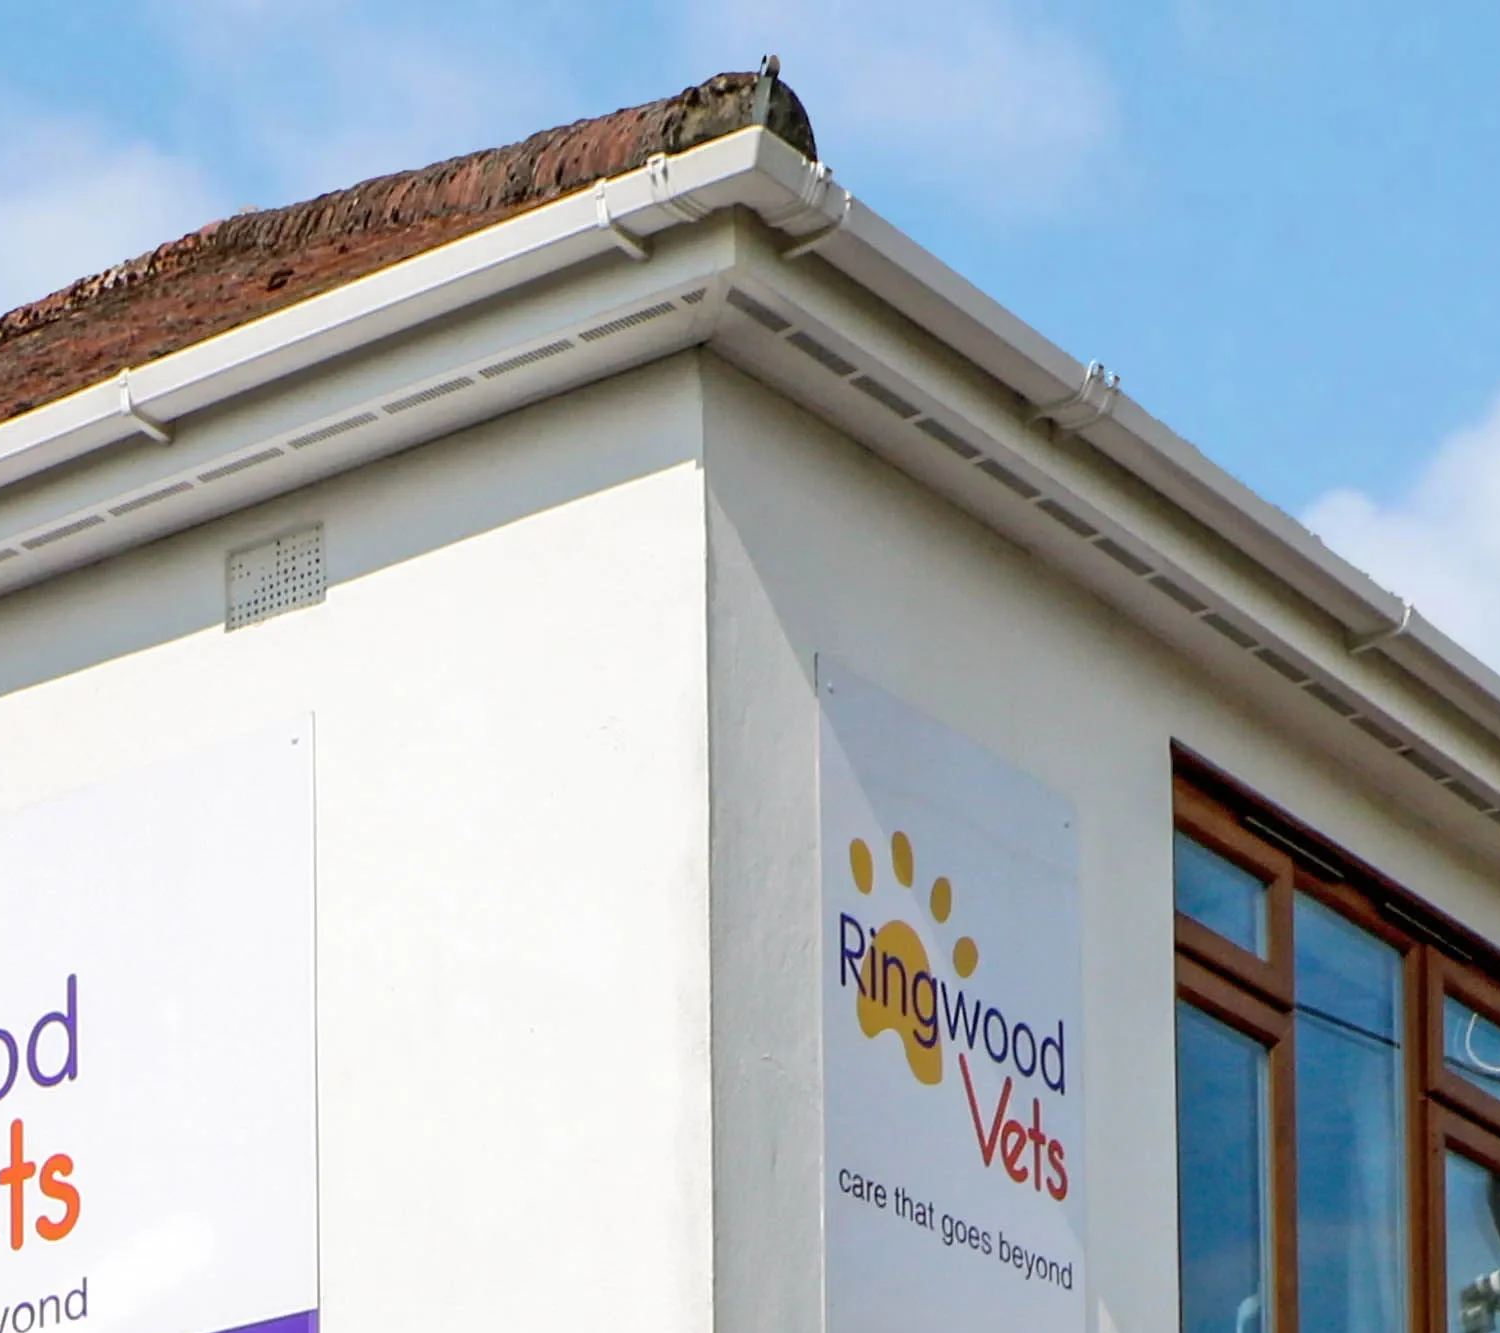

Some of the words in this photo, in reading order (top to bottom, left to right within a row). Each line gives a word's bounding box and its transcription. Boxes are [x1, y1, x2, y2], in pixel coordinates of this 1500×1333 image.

[839, 912, 1066, 1095] Ringwood
[959, 1052, 1068, 1201] Vets
[838, 1166, 887, 1208] care
[894, 1184, 935, 1231] that
[941, 1213, 993, 1262] goes
[998, 1230, 1074, 1291] beyond
